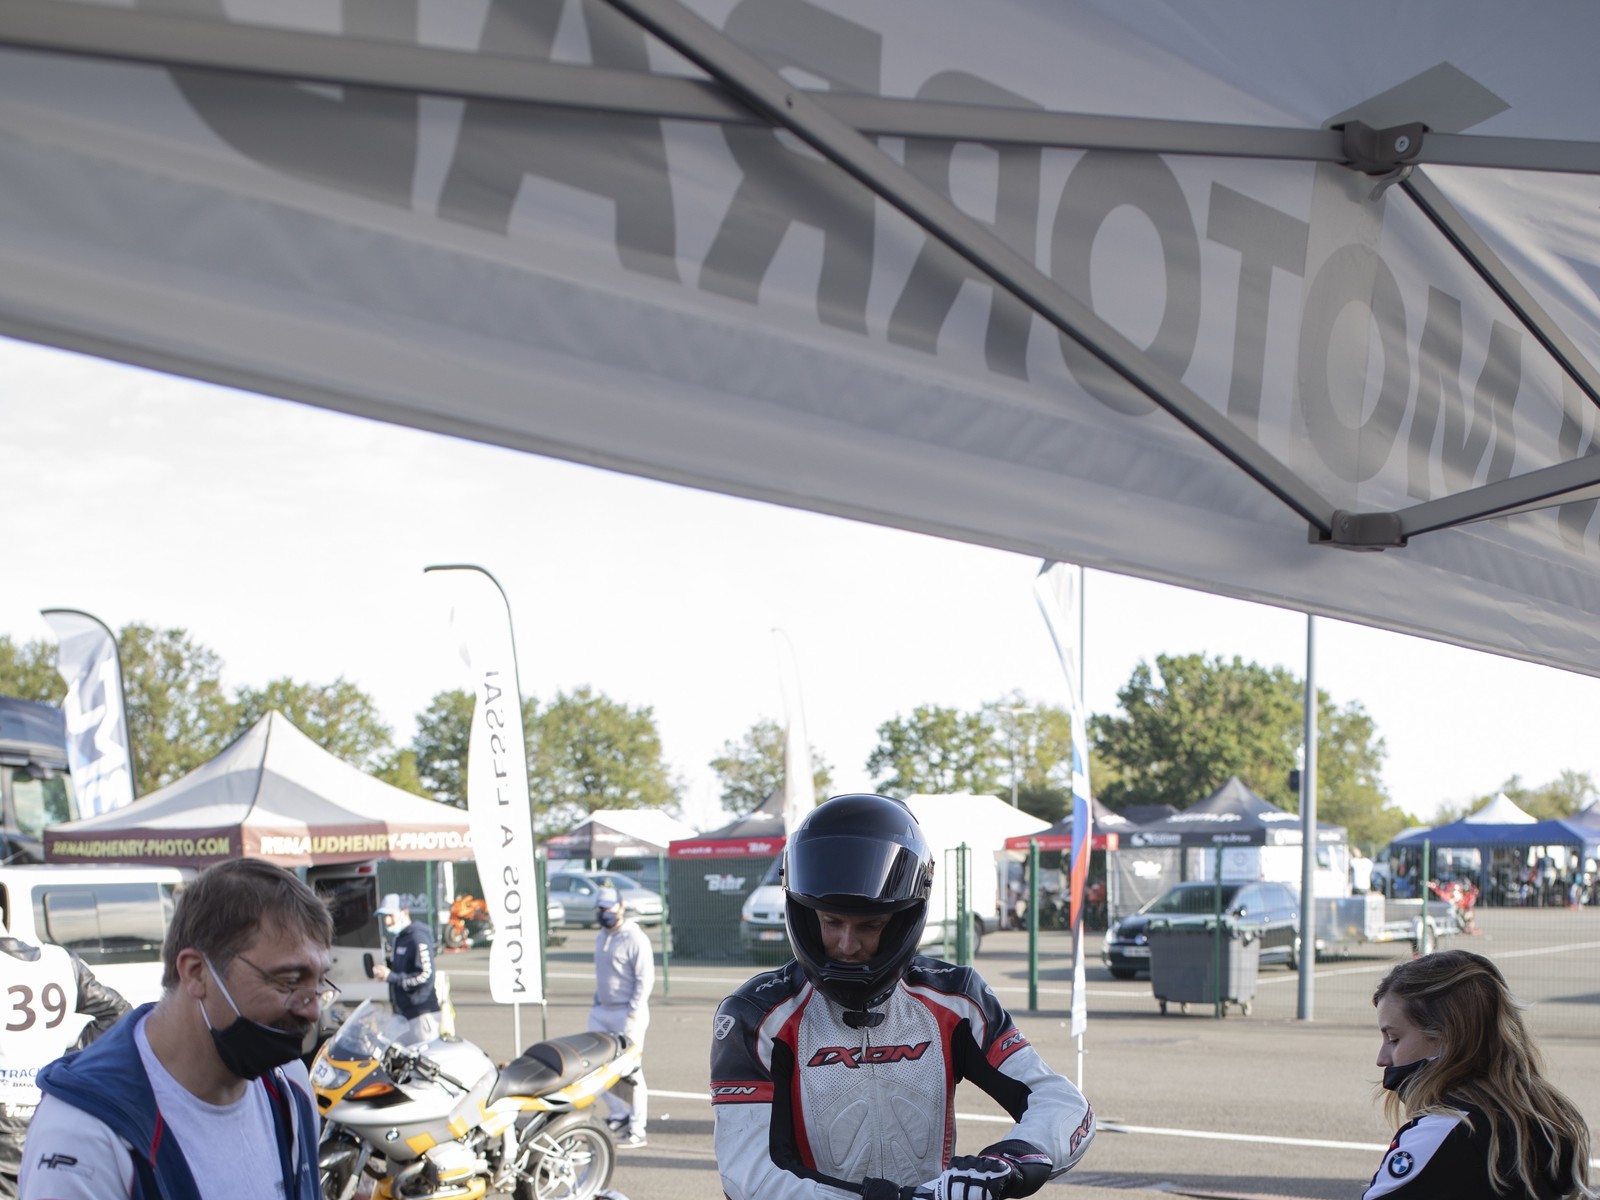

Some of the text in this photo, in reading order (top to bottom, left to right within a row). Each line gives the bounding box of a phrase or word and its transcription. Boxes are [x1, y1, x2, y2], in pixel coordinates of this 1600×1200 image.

[260, 831, 474, 855] RENAUDHENRY-PHOTO.C
[704, 873, 746, 892] Bihr
[5, 982, 67, 1032] 39
[806, 1040, 932, 1069] IXON
[0, 1067, 40, 1079] TRAC
[38, 1153, 78, 1171] HP
